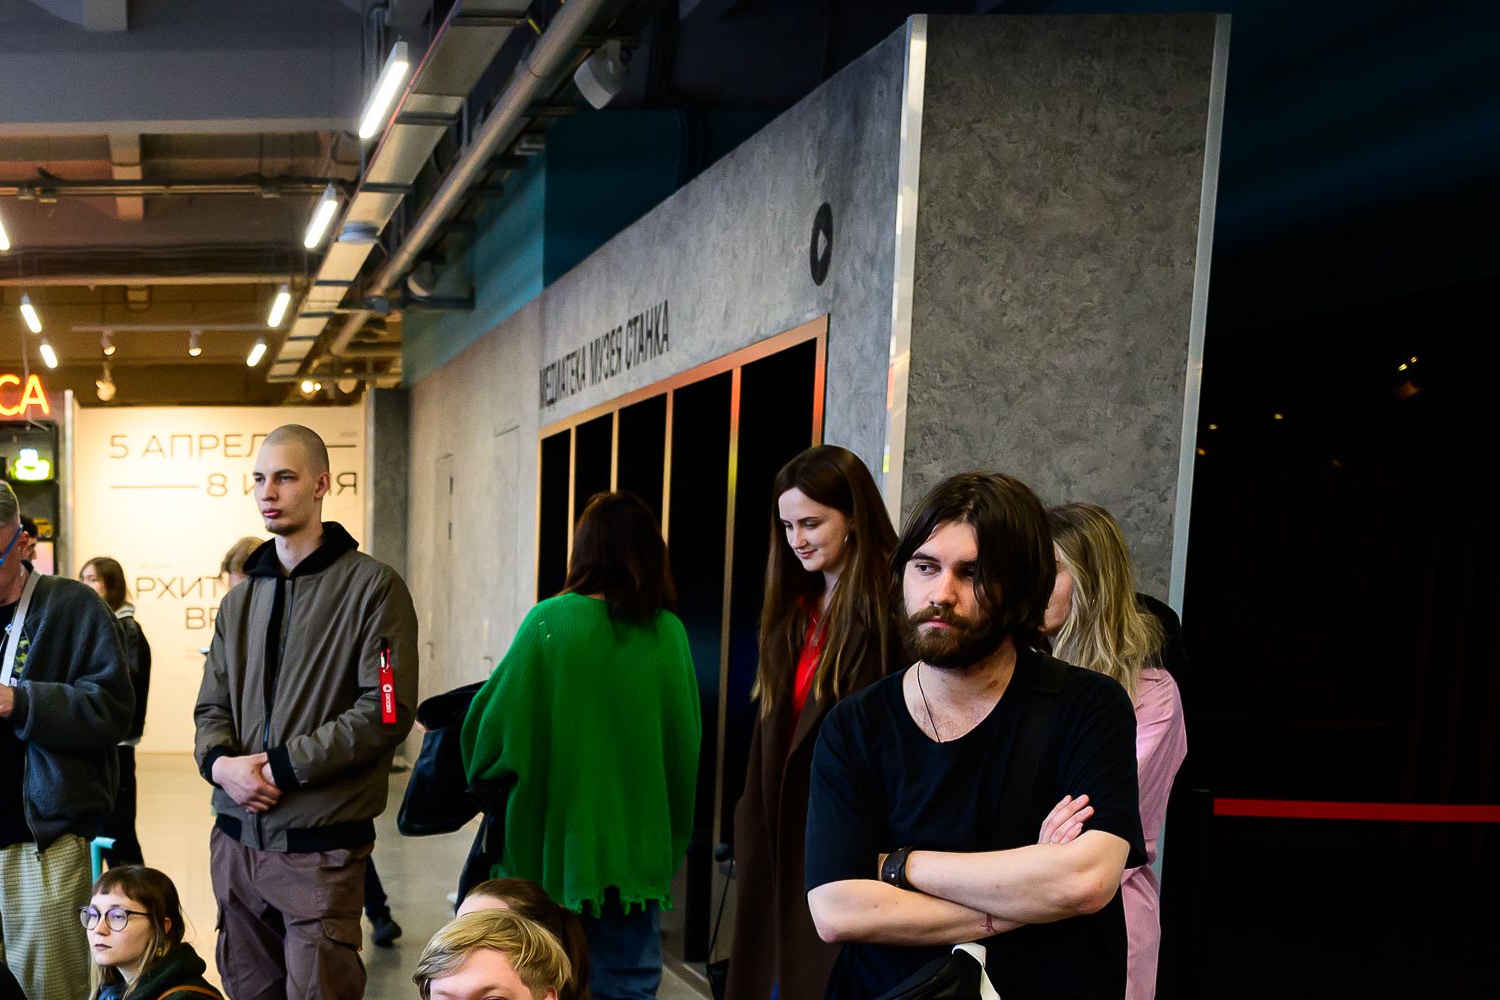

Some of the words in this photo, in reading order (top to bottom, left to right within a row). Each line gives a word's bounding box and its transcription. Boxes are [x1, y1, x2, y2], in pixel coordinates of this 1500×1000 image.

[540, 345, 586, 412] МЕДИАТЕКА
[590, 325, 622, 386] МУЗЕЯ
[626, 299, 669, 370] СТАНКА
[110, 435, 129, 458] 5
[142, 434, 268, 458] АПРЕЛ
[207, 473, 228, 497] 8
